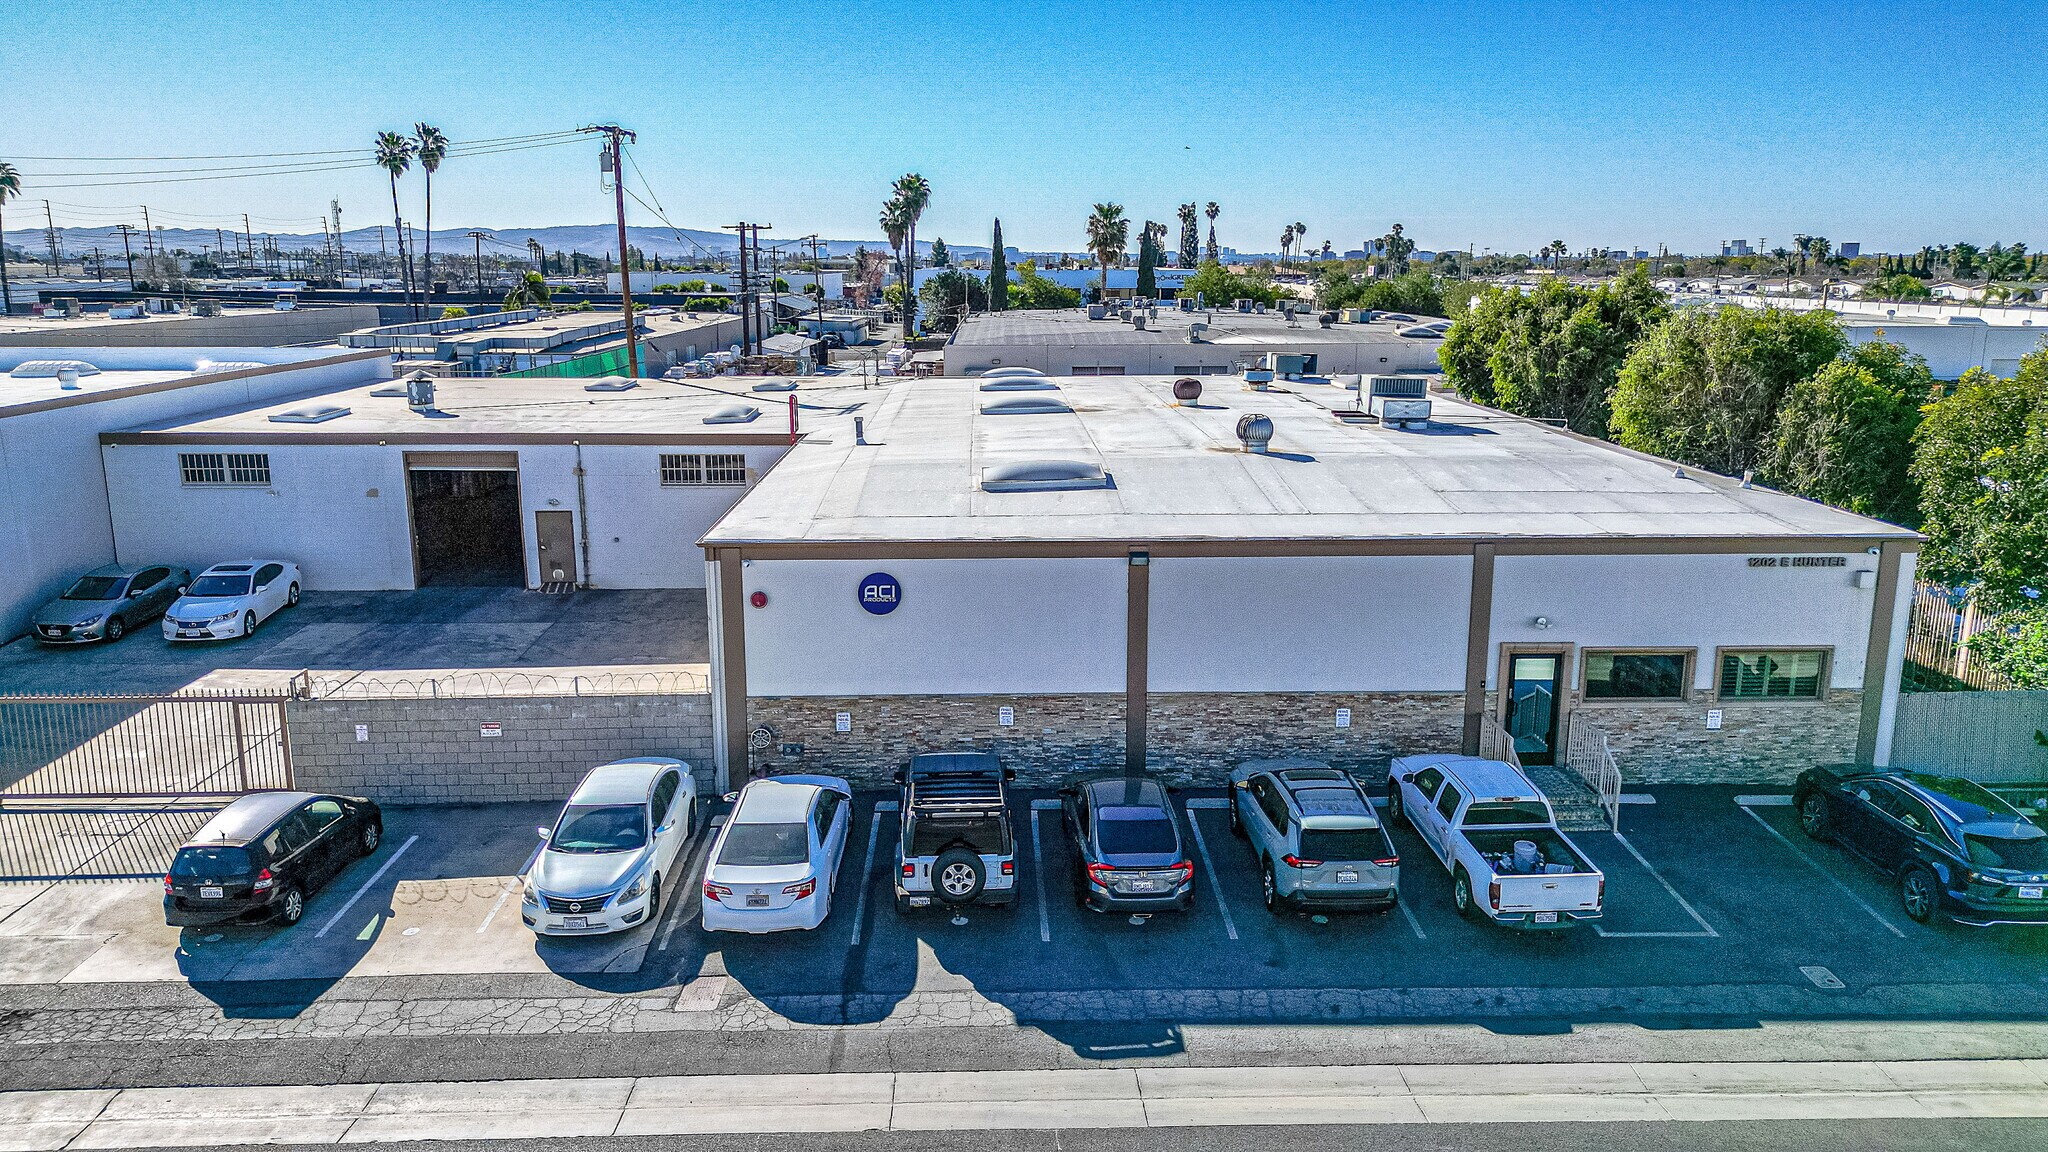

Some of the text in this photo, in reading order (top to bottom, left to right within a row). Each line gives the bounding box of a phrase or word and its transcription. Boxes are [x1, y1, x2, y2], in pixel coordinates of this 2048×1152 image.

[1747, 557, 1846, 567] 1202 E HUNTER
[864, 585, 895, 598] ACI
